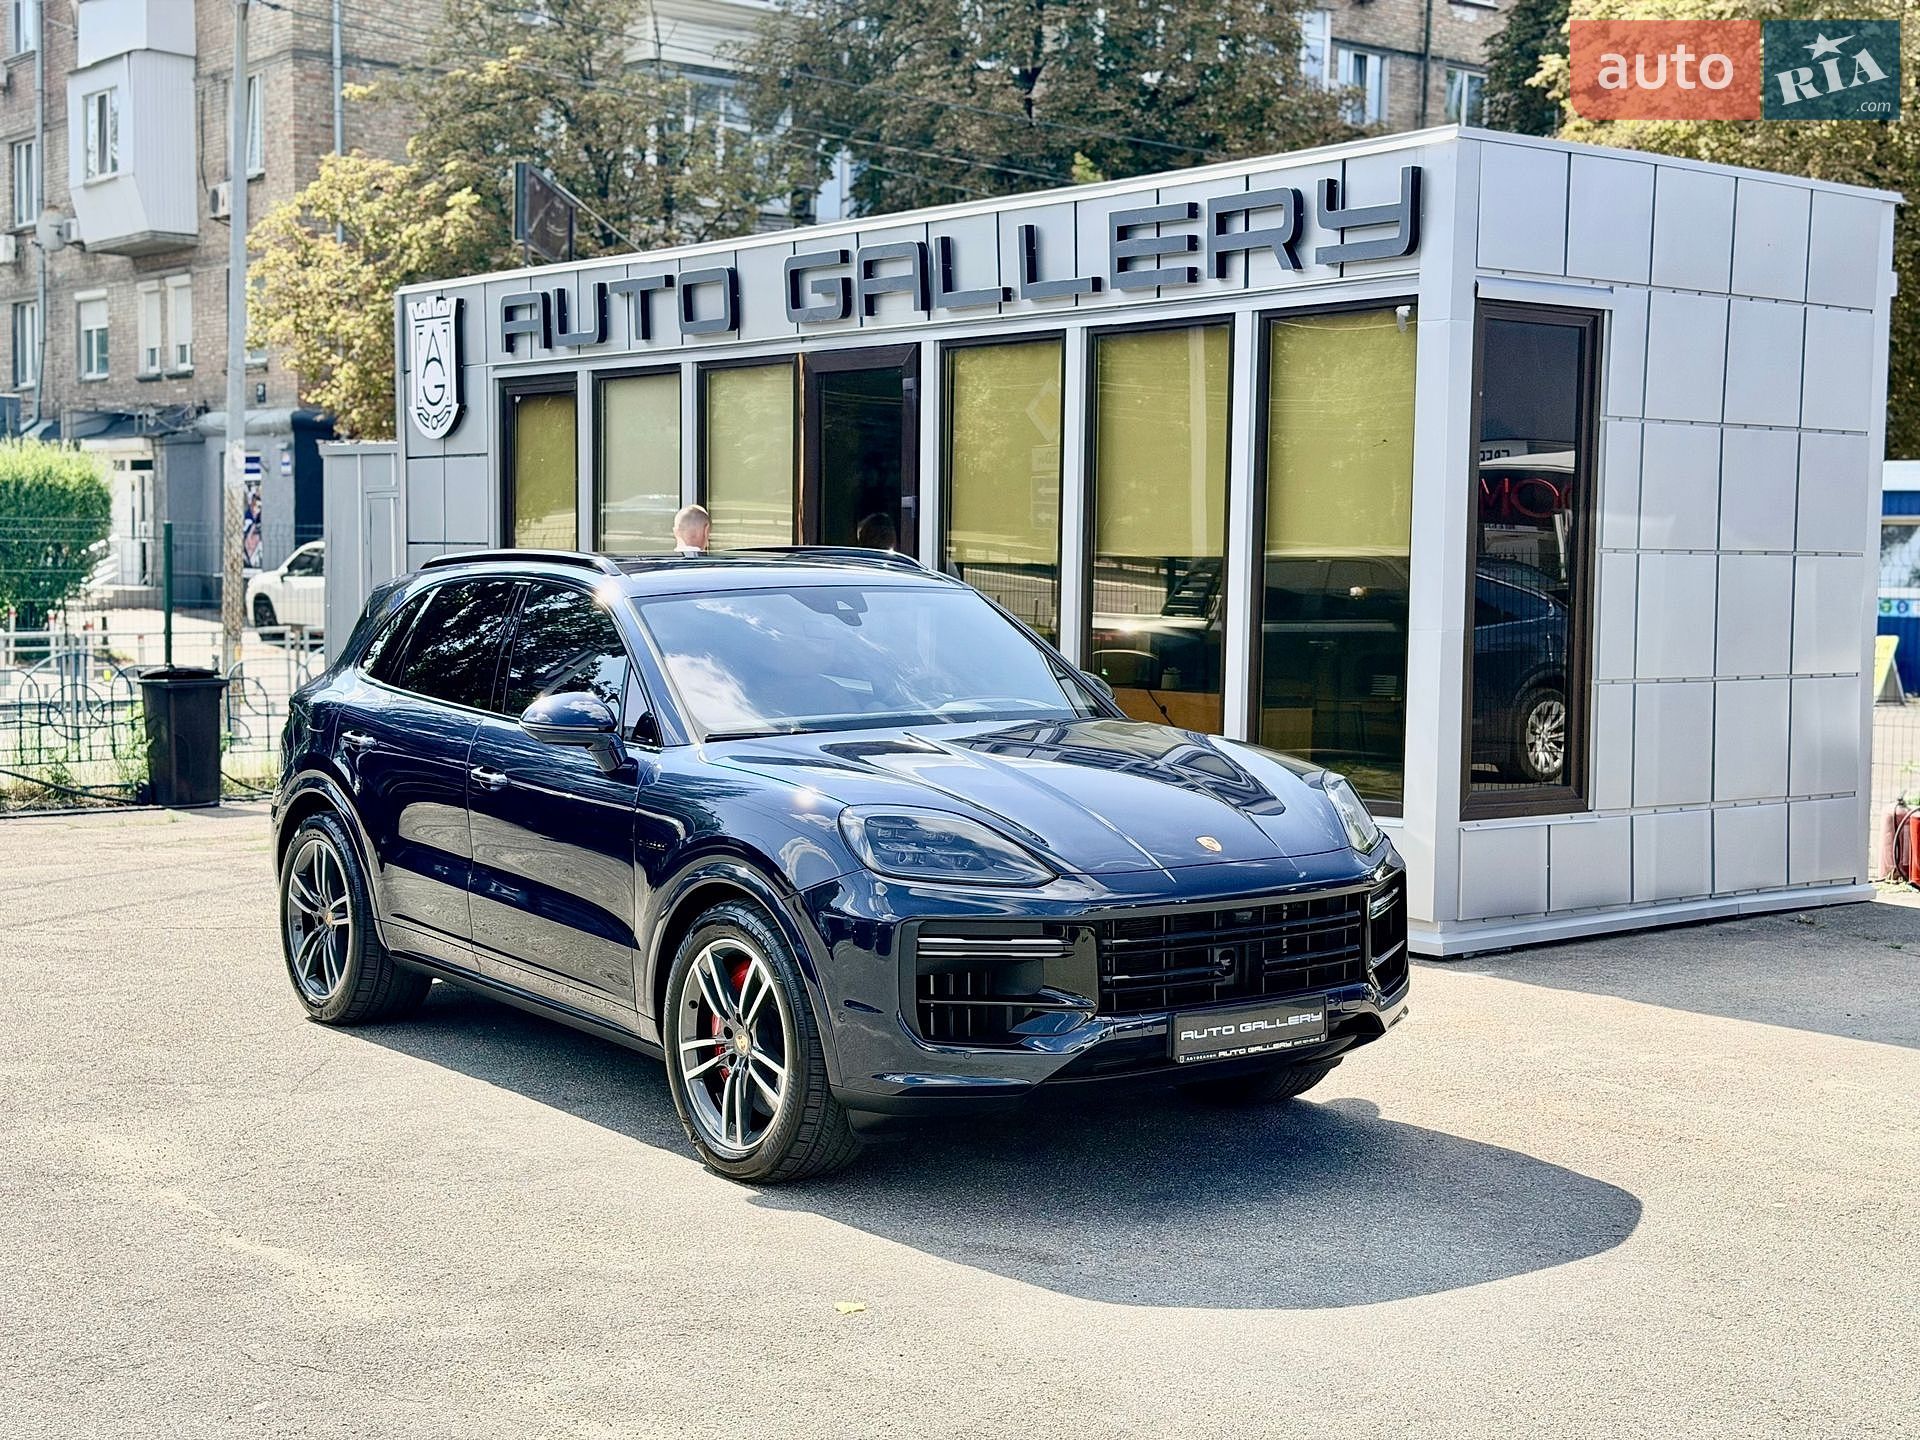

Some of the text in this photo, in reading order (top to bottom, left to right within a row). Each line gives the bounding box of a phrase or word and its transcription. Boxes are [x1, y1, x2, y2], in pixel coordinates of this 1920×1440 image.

[499, 165, 1422, 353] AUTO GALLERY
[1180, 1011, 1323, 1041] AUTO GALLERY
[1218, 1048, 1247, 1057] AUTO
[1247, 1041, 1293, 1054] GALLERY
